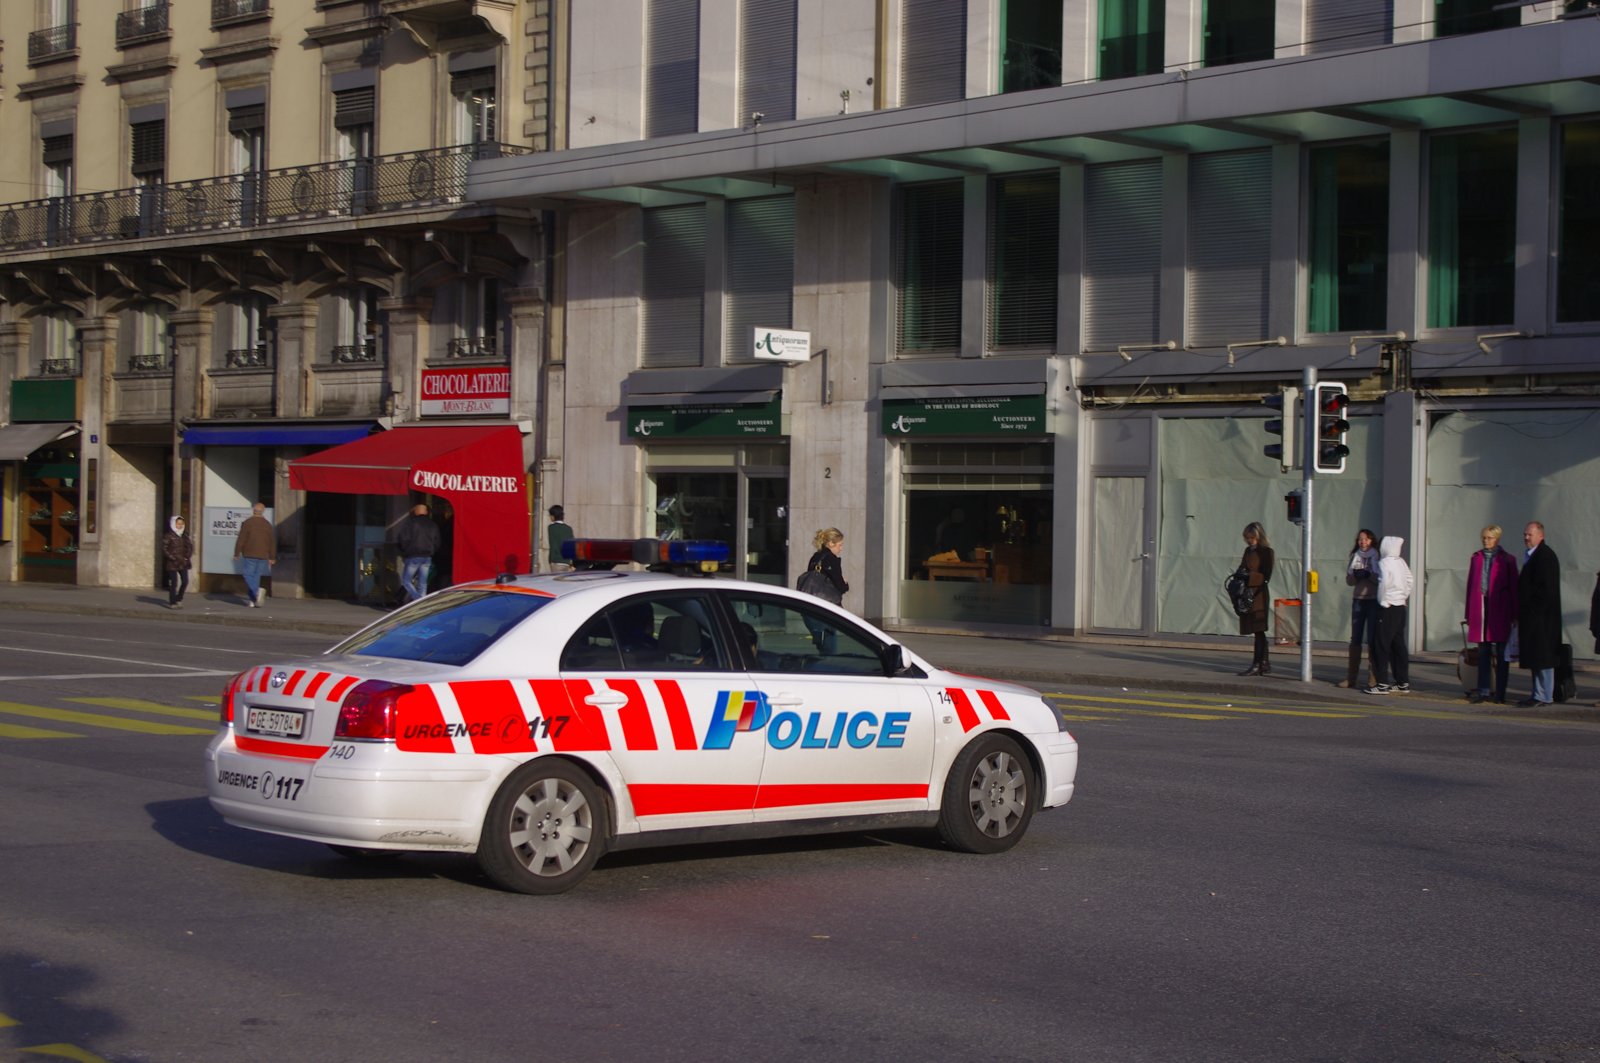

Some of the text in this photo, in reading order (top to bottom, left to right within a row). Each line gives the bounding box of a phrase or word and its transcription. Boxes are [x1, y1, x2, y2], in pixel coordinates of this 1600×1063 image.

[756, 333, 808, 356] Antiquorum
[423, 373, 511, 395] CHOCOLATERIE
[441, 401, 494, 413] MONT-BLANC
[413, 470, 518, 493] CHOCOLATERIE
[824, 466, 832, 479] 2
[213, 521, 237, 529] ARCADE
[936, 690, 959, 705] 140
[403, 715, 570, 739] URGENCE 117
[702, 690, 912, 750] POLICE
[329, 744, 356, 760] 140
[218, 770, 305, 801] URGENCE 117
